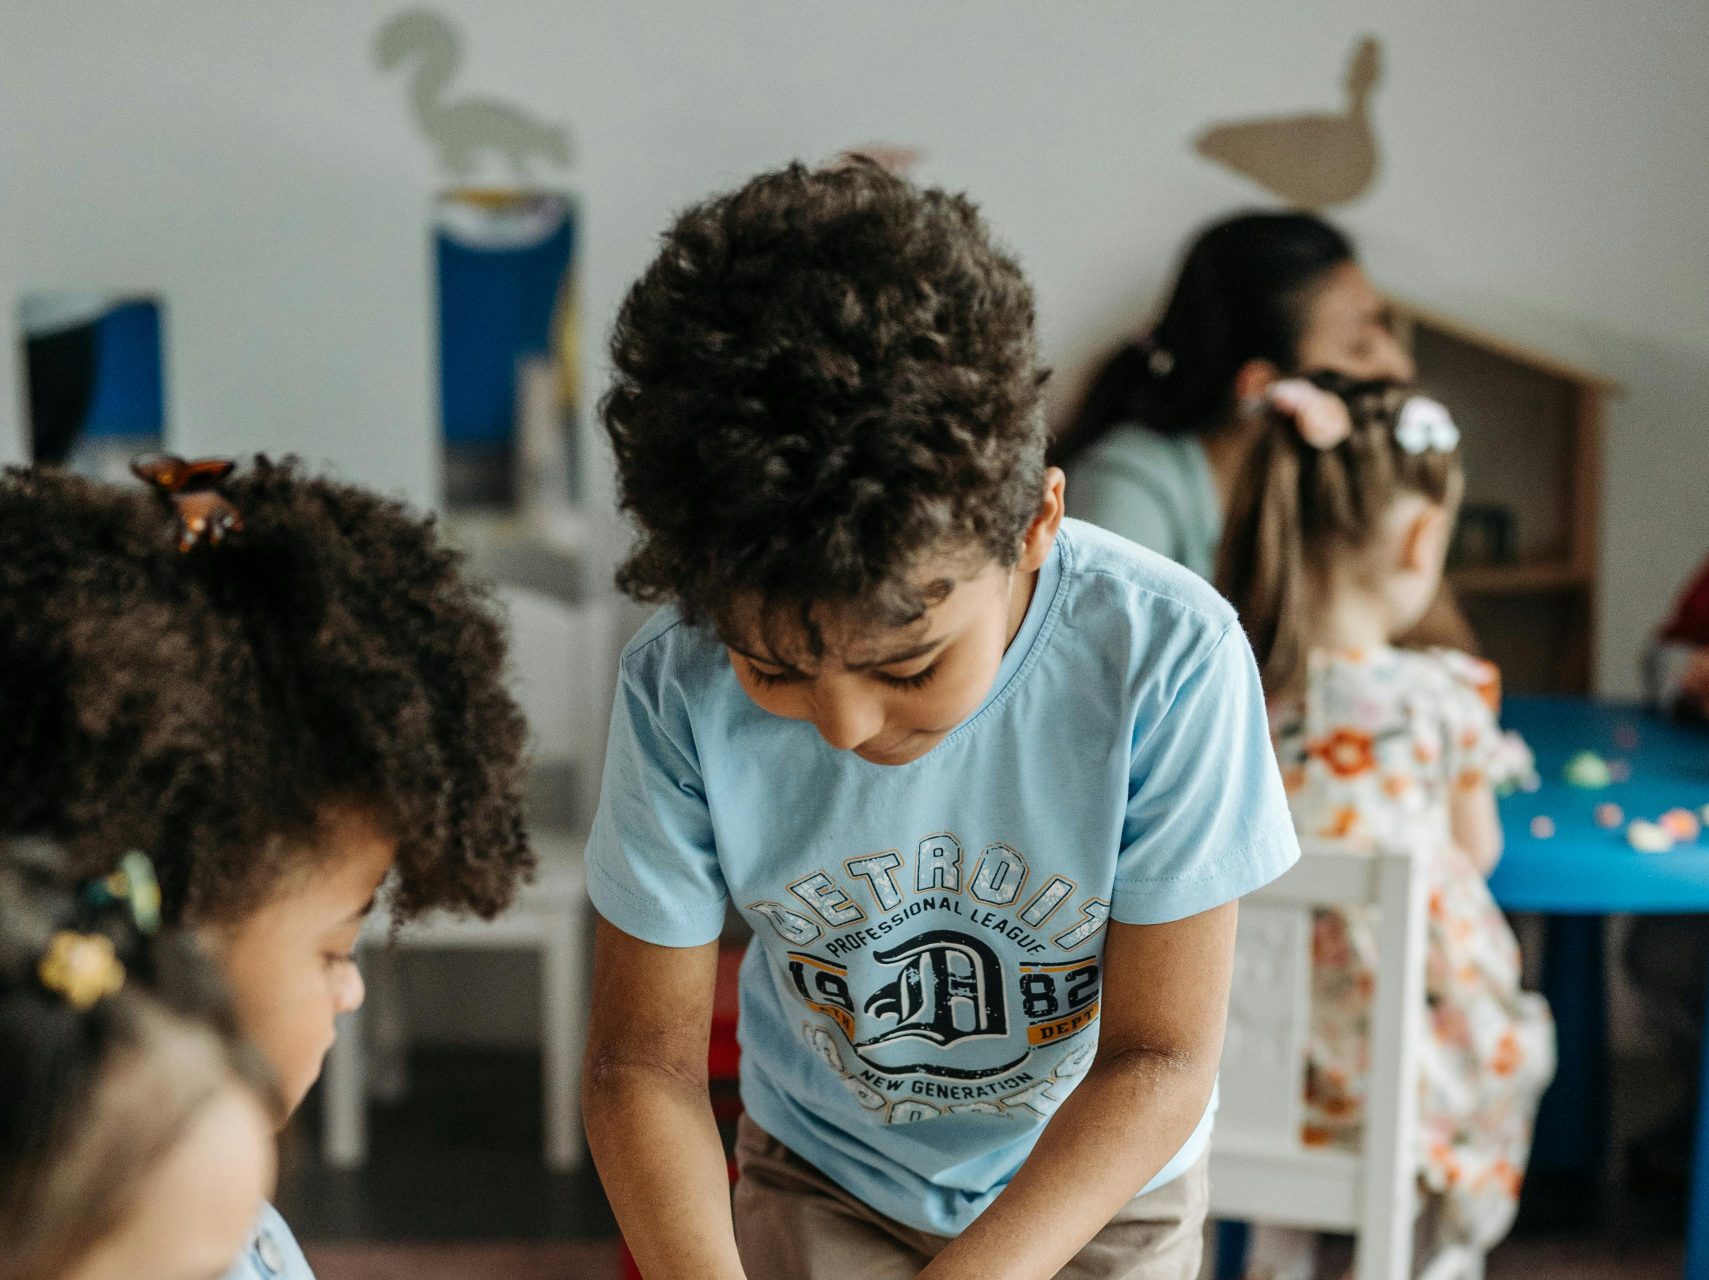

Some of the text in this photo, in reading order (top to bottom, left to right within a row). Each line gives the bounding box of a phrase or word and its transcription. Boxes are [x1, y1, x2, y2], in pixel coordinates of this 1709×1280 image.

[745, 832, 1110, 952] DETROIT
[825, 897, 1046, 958] PROFESSIONAL LEAGUE
[788, 961, 1099, 1018] 19 82
[1040, 1008, 1094, 1039] DEPT
[860, 1069, 1034, 1100] NEW GENERATION
